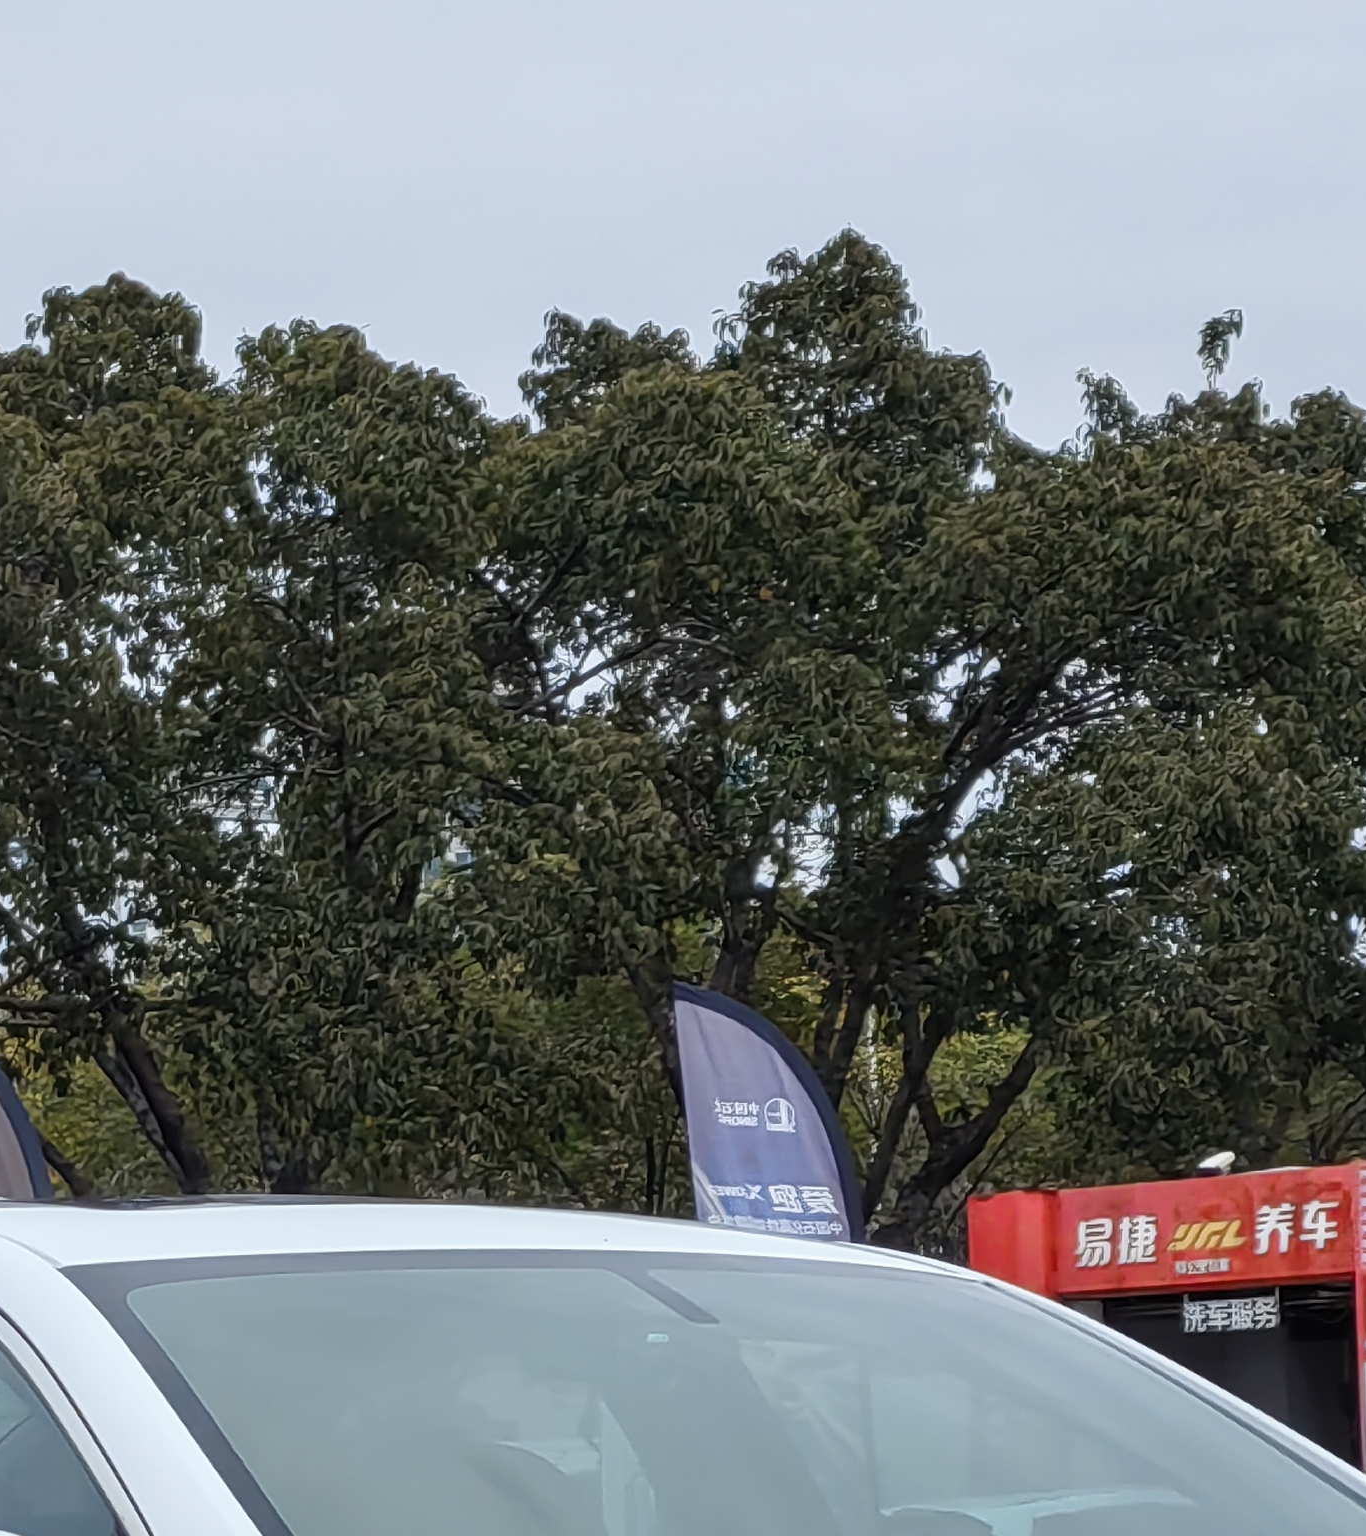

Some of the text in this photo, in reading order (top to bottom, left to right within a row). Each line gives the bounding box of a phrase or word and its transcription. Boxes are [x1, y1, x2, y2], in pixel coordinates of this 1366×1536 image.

[1075, 1215, 1158, 1267] 易捷
[1255, 1200, 1340, 1255] 养车
[1184, 1298, 1280, 1333] 洗车服务
